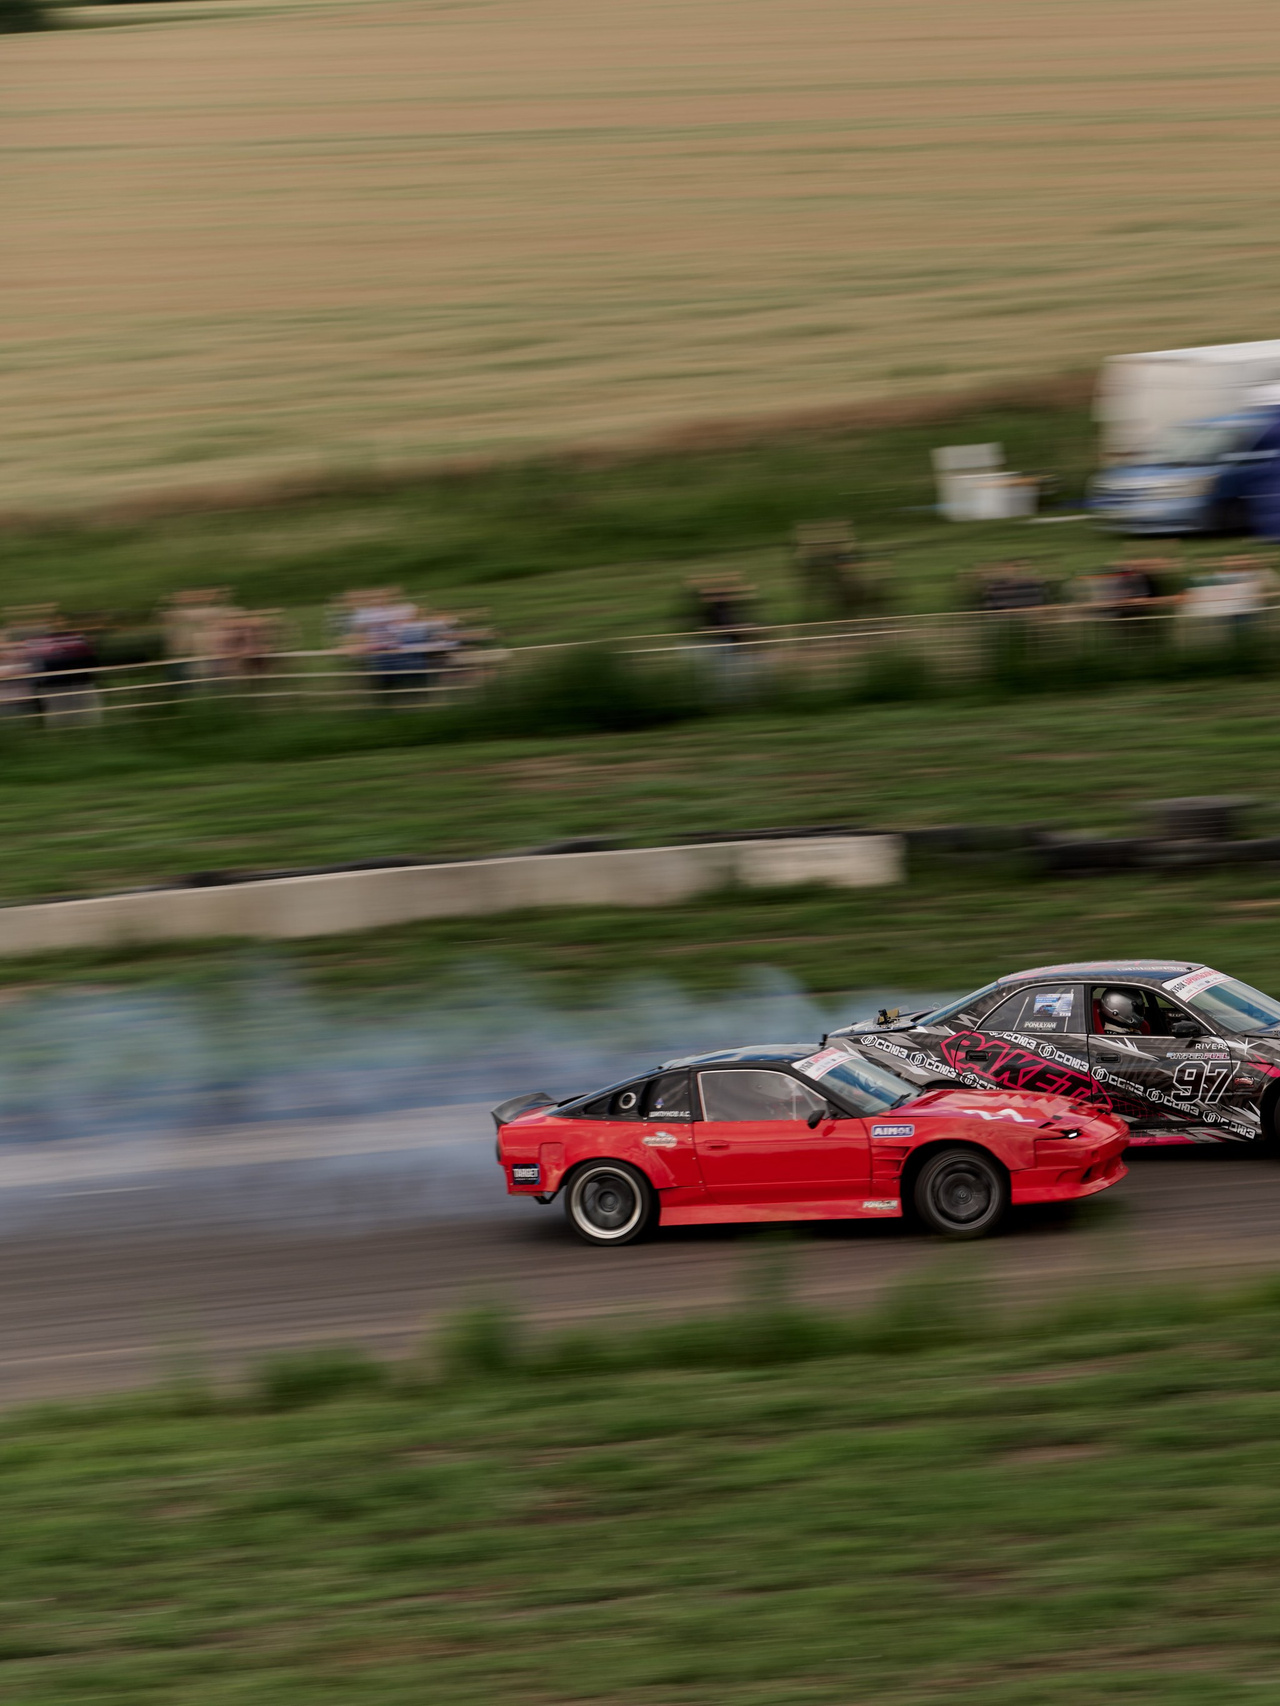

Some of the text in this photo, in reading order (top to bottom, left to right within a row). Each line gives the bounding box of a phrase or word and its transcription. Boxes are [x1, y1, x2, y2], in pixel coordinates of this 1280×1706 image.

[875, 1041, 908, 1059] СОЮЗ
[1003, 1032, 1037, 1050] СОЮЗ
[925, 1060, 959, 1079] СОЮЗ
[1054, 1052, 1089, 1072] СОЮЗ
[1171, 1061, 1241, 1104] 97
[874, 1126, 912, 1136] AIMOL
